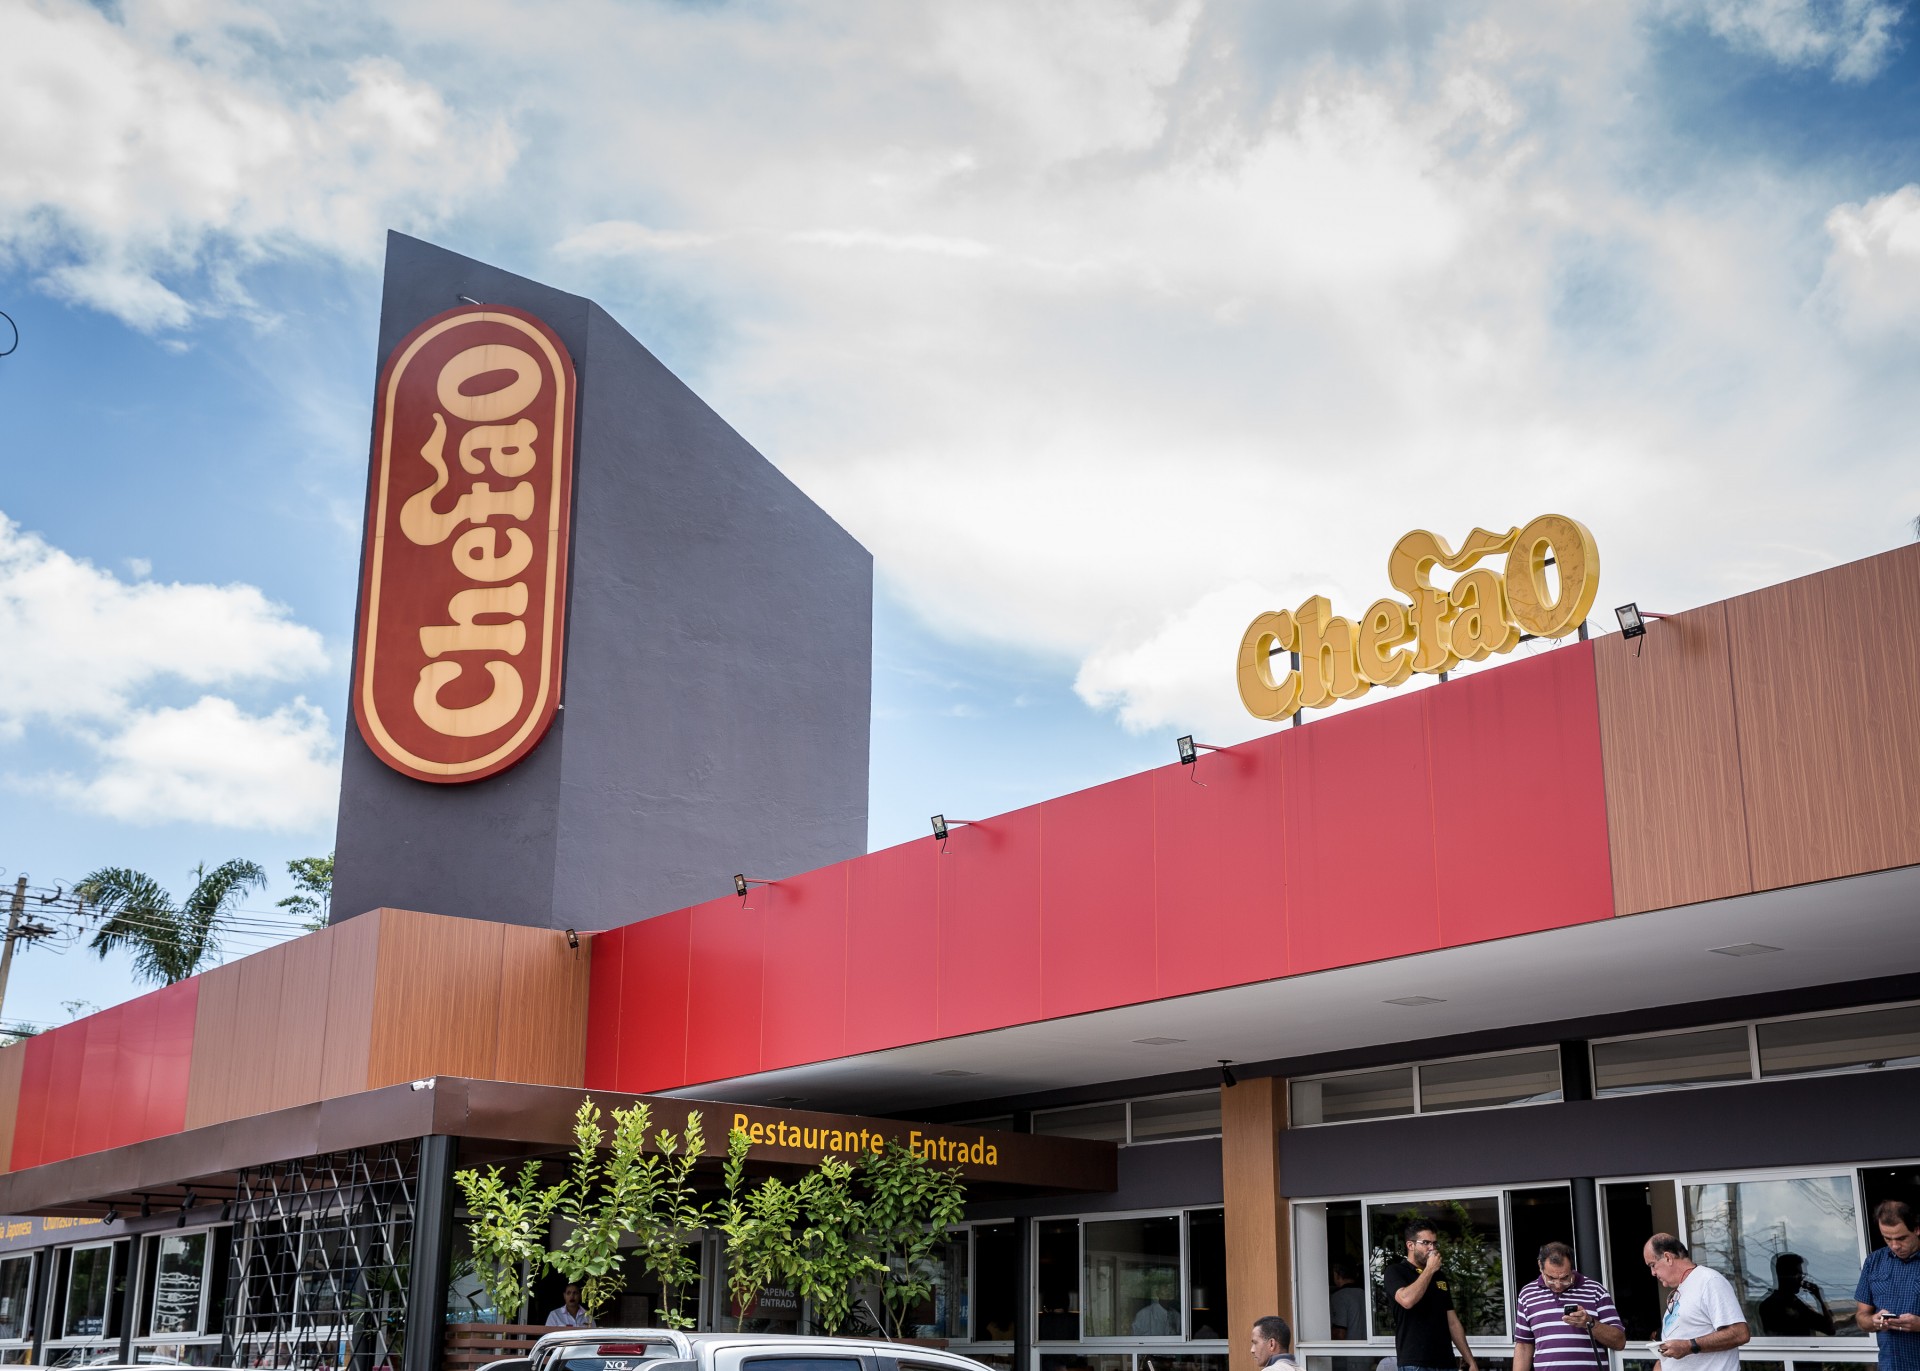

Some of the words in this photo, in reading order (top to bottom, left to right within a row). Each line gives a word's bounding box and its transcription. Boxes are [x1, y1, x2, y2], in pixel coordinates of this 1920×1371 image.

[733, 1113, 884, 1153] Restaurante
[909, 1130, 998, 1166] Entrada
[763, 1287, 795, 1298] APENAS
[760, 1298, 798, 1309] ENTRADA
